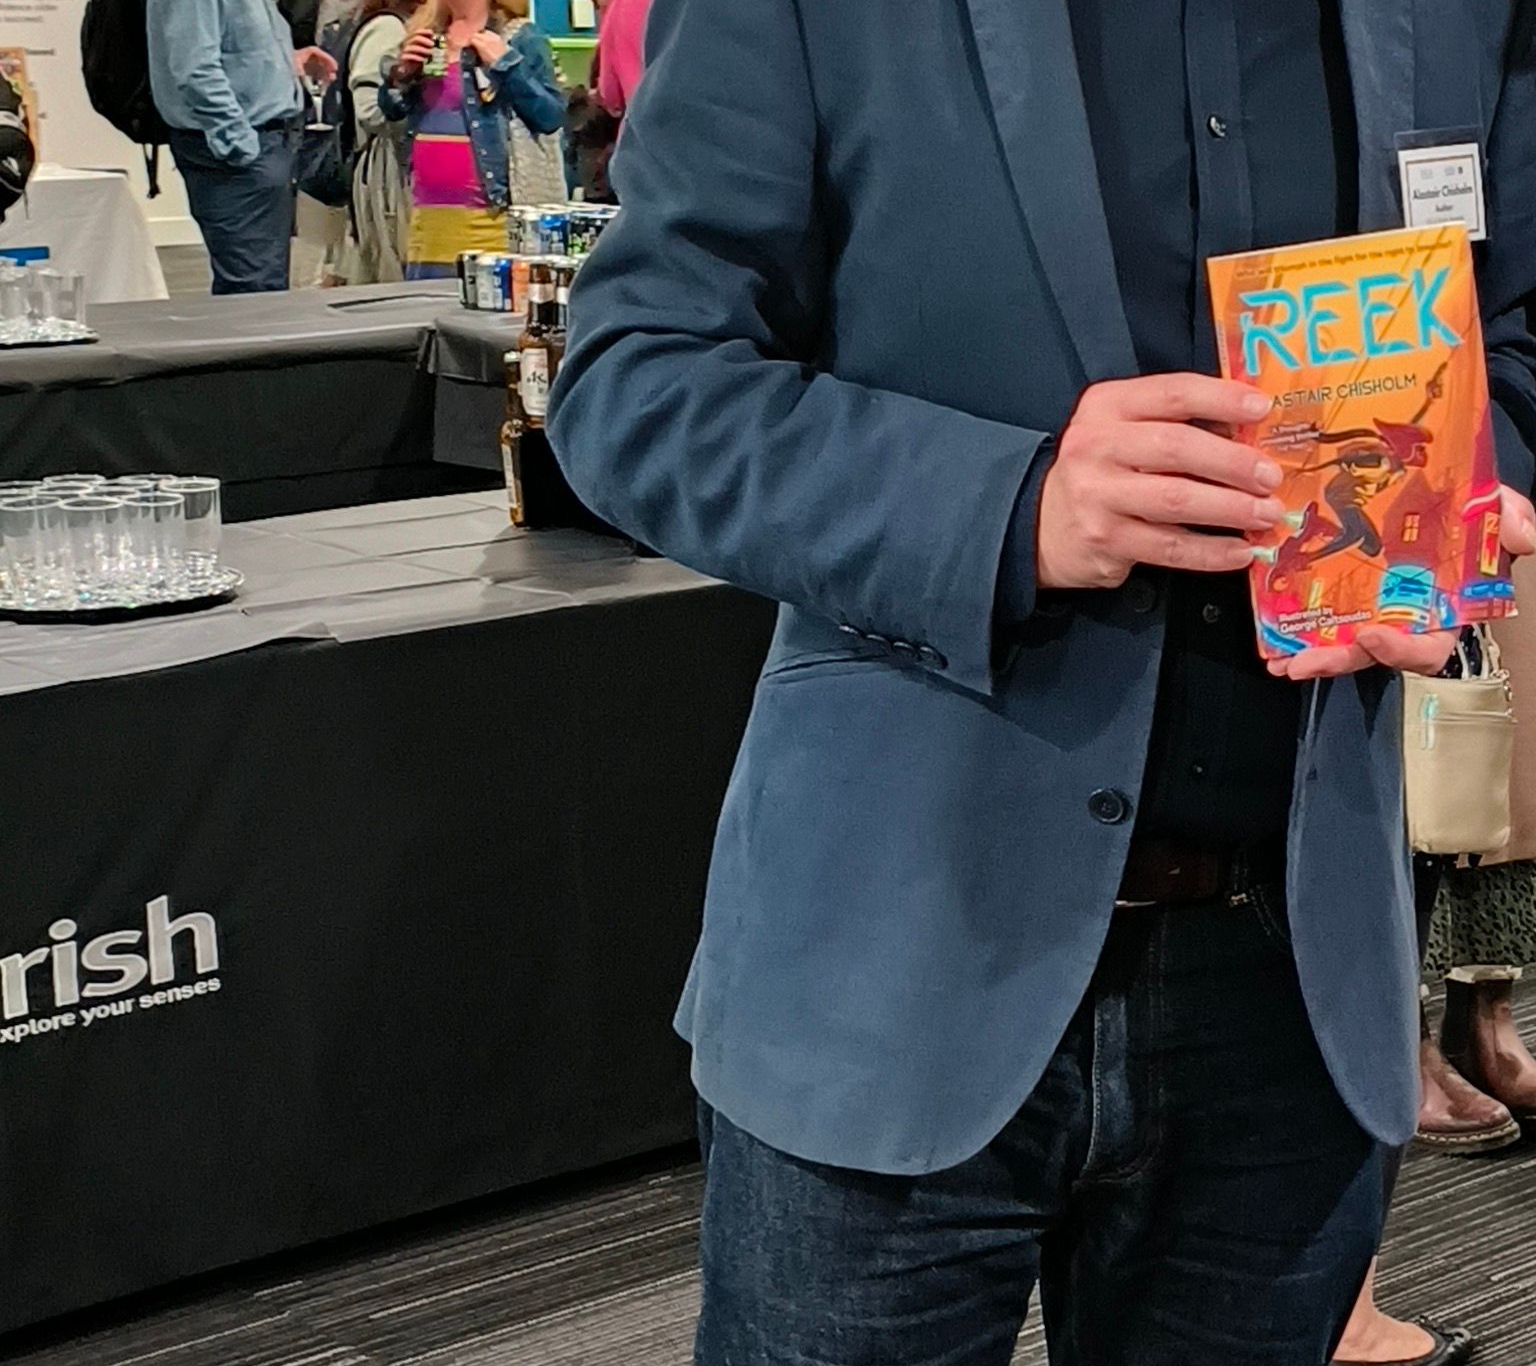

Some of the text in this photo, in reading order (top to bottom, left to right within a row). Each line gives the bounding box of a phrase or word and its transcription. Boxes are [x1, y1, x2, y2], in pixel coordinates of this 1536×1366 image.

[1238, 265, 1466, 377] REEK
[1271, 372, 1418, 410] ASTAIR CHISHOLM
[0, 895, 220, 1020] rish
[0, 976, 222, 1043] xplore your senses
